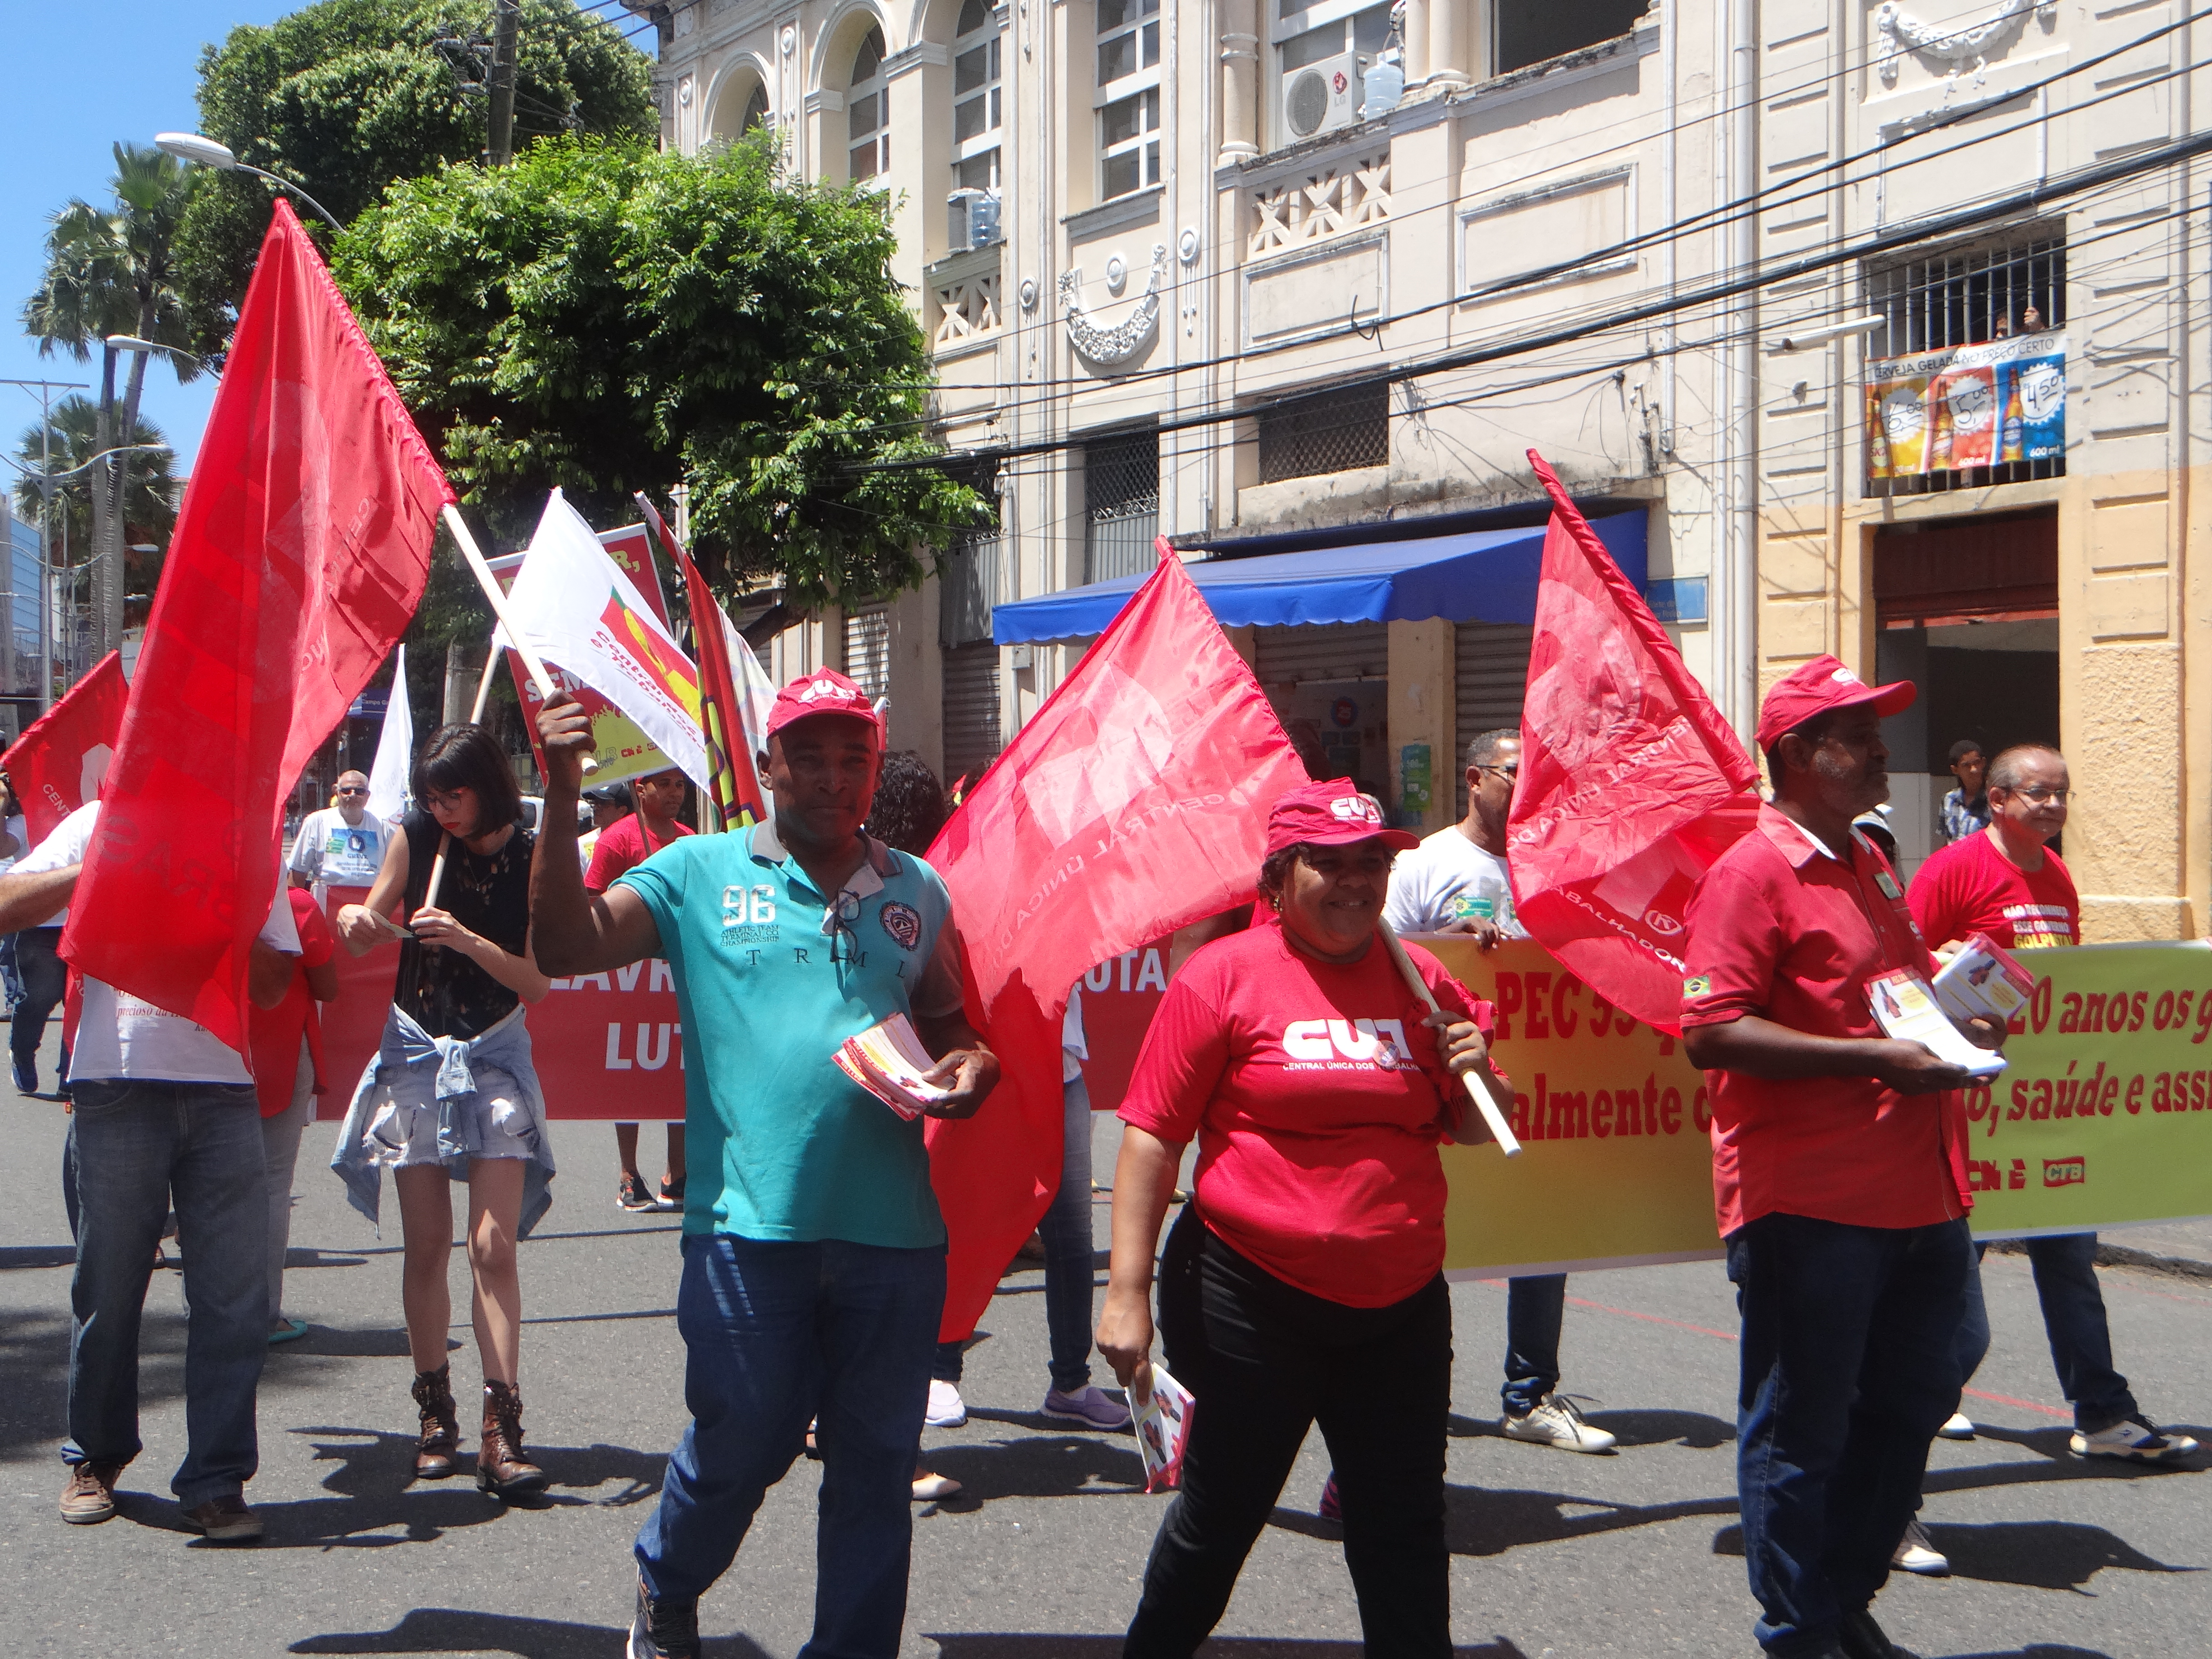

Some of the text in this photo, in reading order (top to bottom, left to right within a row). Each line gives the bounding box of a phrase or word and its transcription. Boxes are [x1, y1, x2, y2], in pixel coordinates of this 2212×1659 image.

[1918, 356, 1959, 371] GELADA
[1983, 346, 2015, 360] PREÇO
[2018, 338, 2054, 354] CERTO
[2030, 445, 2061, 457] 600 ml
[1959, 457, 1974, 466] 600
[723, 884, 776, 927] 96
[2002, 903, 2026, 919] NÃO
[721, 926, 756, 936] ATHLETIC
[2012, 920, 2034, 933] ESSE
[720, 936, 779, 947] CHAMPIONSHIP
[722, 931, 764, 942] TERMINAL
[1074, 948, 1167, 993] UTA
[117, 1004, 153, 1020] precioso
[1495, 971, 1581, 1040] PEC
[2058, 991, 2149, 1035] anos
[2153, 989, 2195, 1031] os
[1282, 1018, 1414, 1059] CUT
[861, 1053, 872, 1064] 241
[1282, 1062, 1324, 1070] CENTRAL
[1327, 1060, 1354, 1070] ÚNICA
[1355, 1062, 1375, 1070] DOS
[2006, 1059, 2119, 1122] saúde
[2124, 1073, 2145, 1115] e
